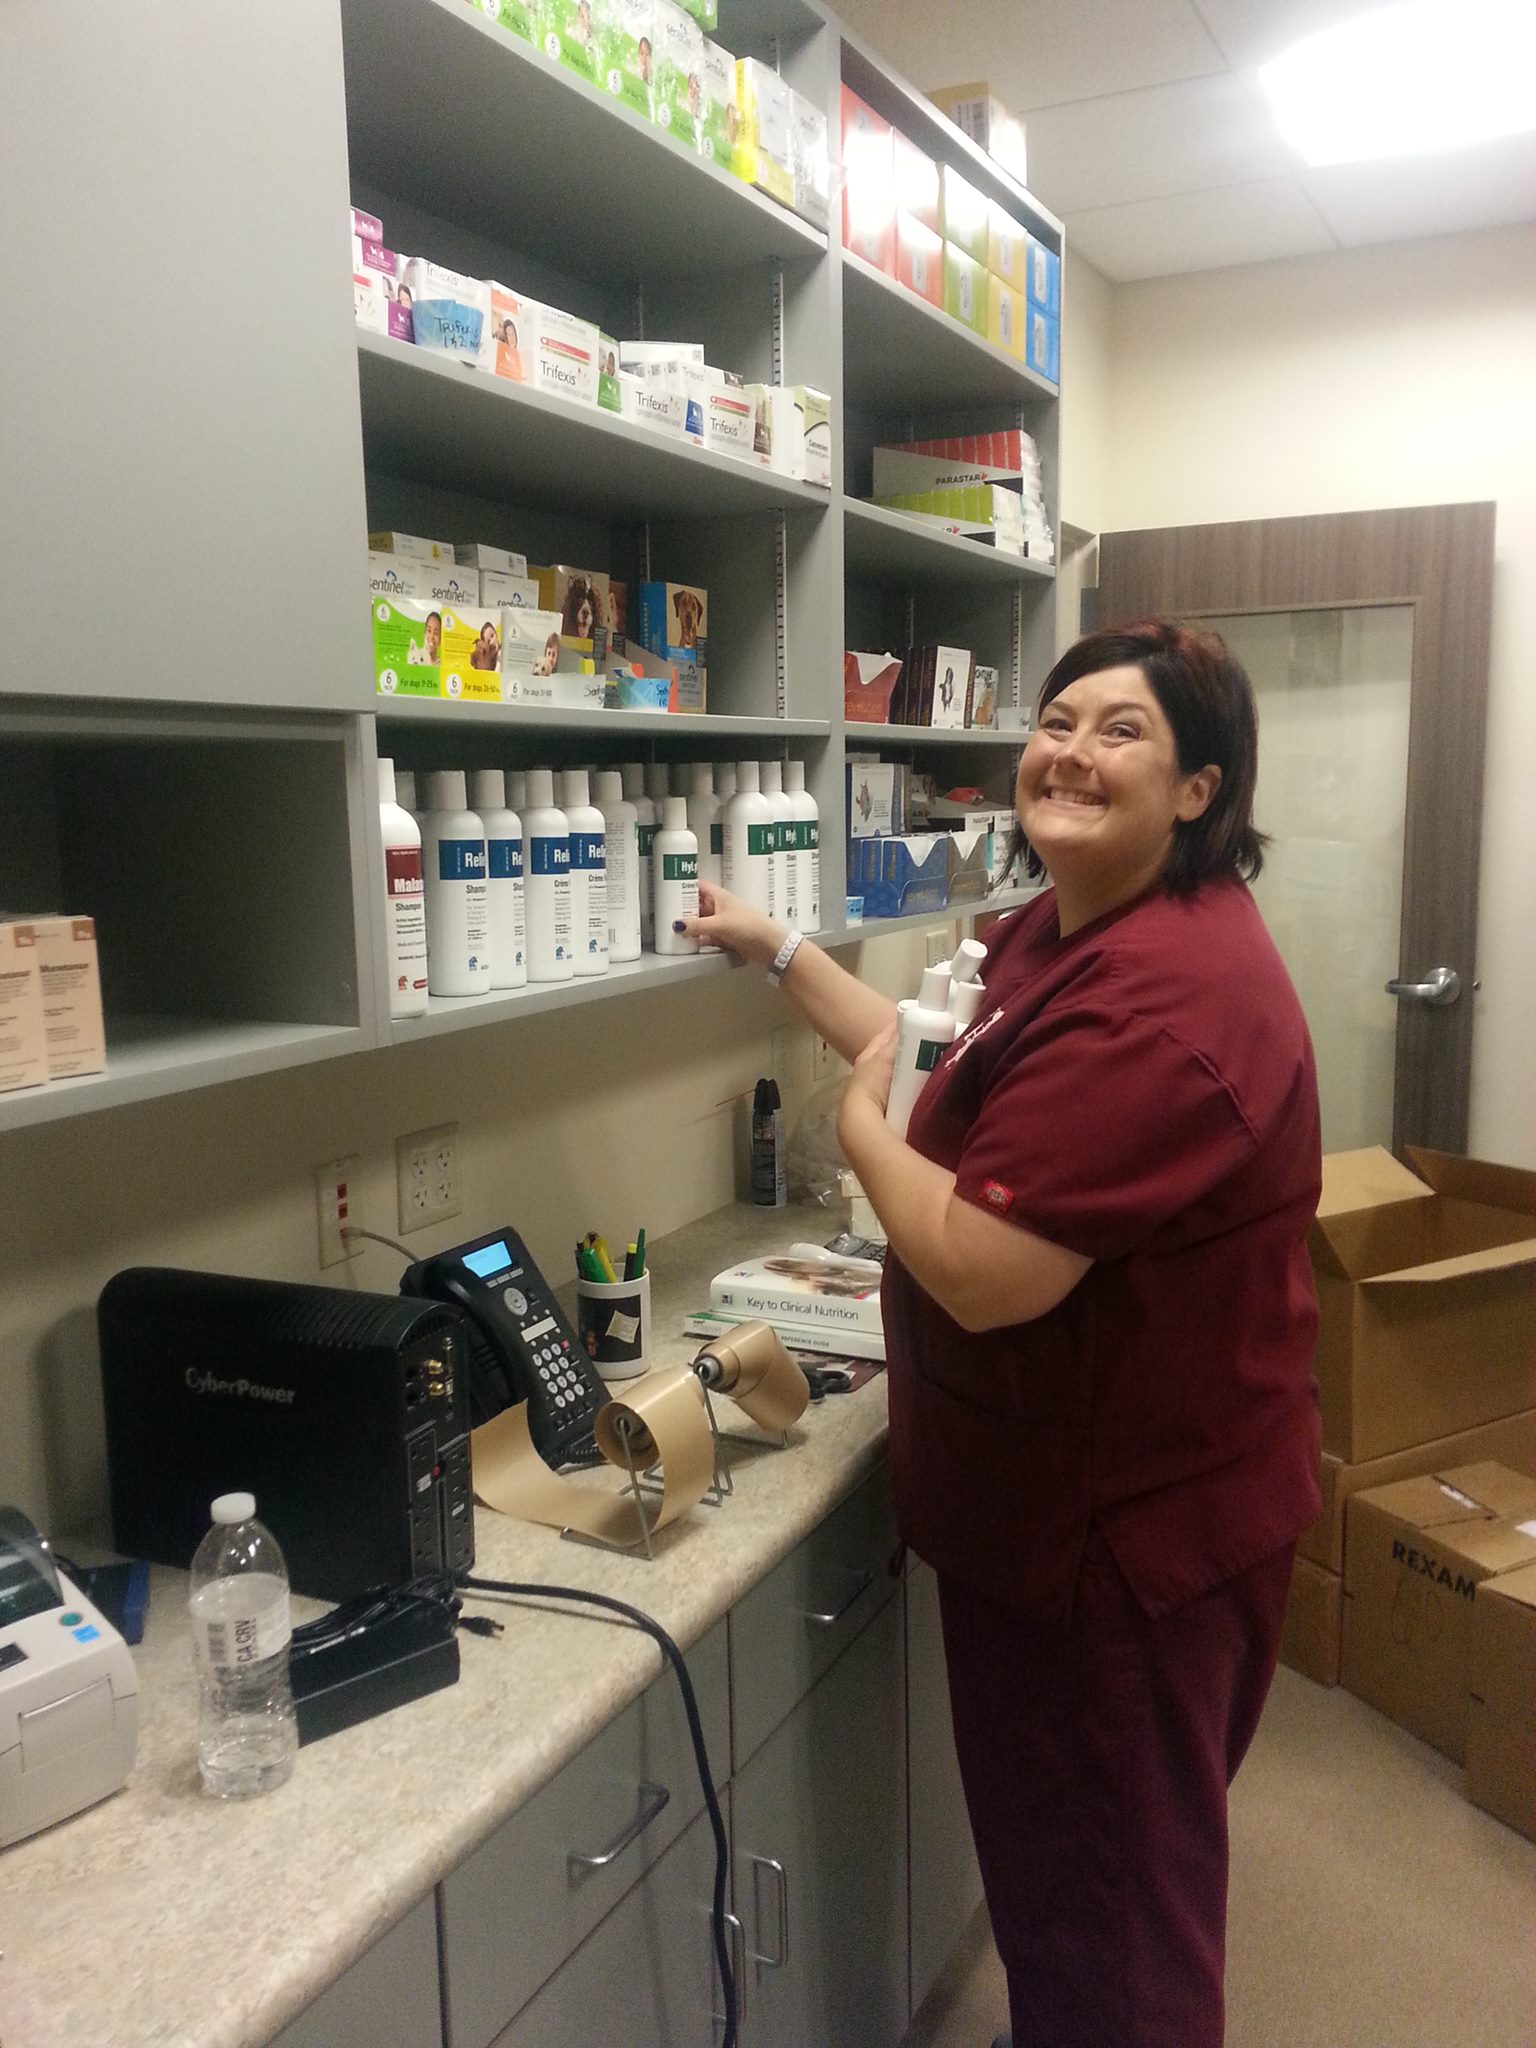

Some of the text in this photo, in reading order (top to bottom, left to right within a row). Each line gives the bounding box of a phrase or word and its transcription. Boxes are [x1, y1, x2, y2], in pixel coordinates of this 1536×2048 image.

[540, 359, 577, 386] Trifexis
[635, 390, 669, 414] Trifexis
[710, 416, 738, 437] Trifexis
[936, 473, 980, 485] PARASTAR
[431, 587, 466, 604] sentinel
[386, 672, 392, 684] 6
[451, 676, 458, 688] 6
[512, 682, 518, 694] 6
[747, 1296, 859, 1321] Key to Clinical Nutrition
[812, 1338, 830, 1347] GUIDE
[185, 1366, 296, 1405] CyberPower
[1391, 1538, 1476, 1602] REXAM
[236, 1644, 253, 1663] CA
